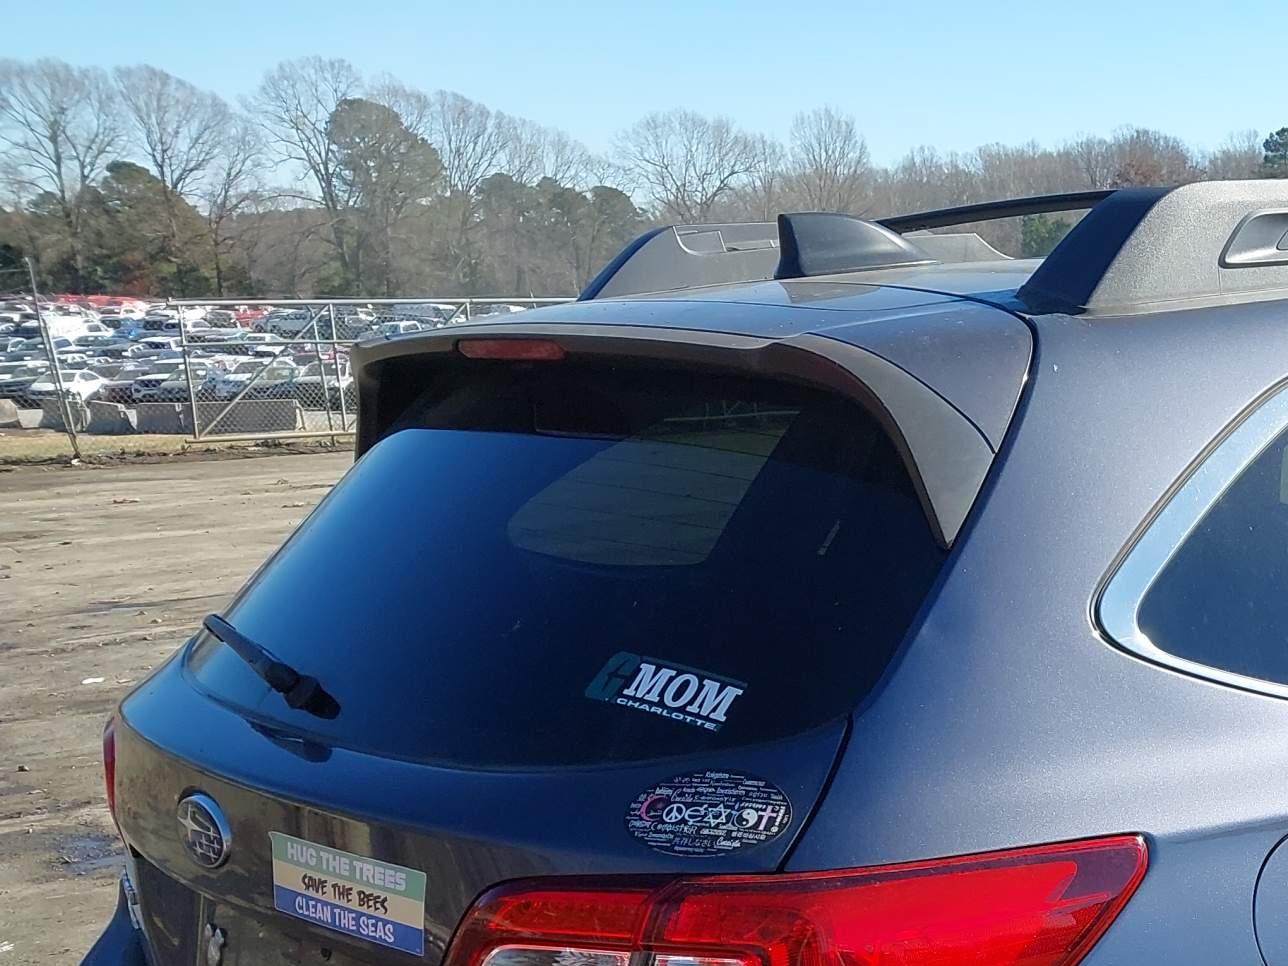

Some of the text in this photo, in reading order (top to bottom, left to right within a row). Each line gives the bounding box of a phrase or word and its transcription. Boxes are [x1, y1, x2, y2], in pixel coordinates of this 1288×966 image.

[616, 698, 717, 731] CHARLOTTE
[622, 662, 745, 722] MOM
[287, 841, 407, 891] HUG THE TREES
[302, 873, 388, 914] SAVE THE BEES
[295, 896, 395, 943] CLEAN THE SEAS
